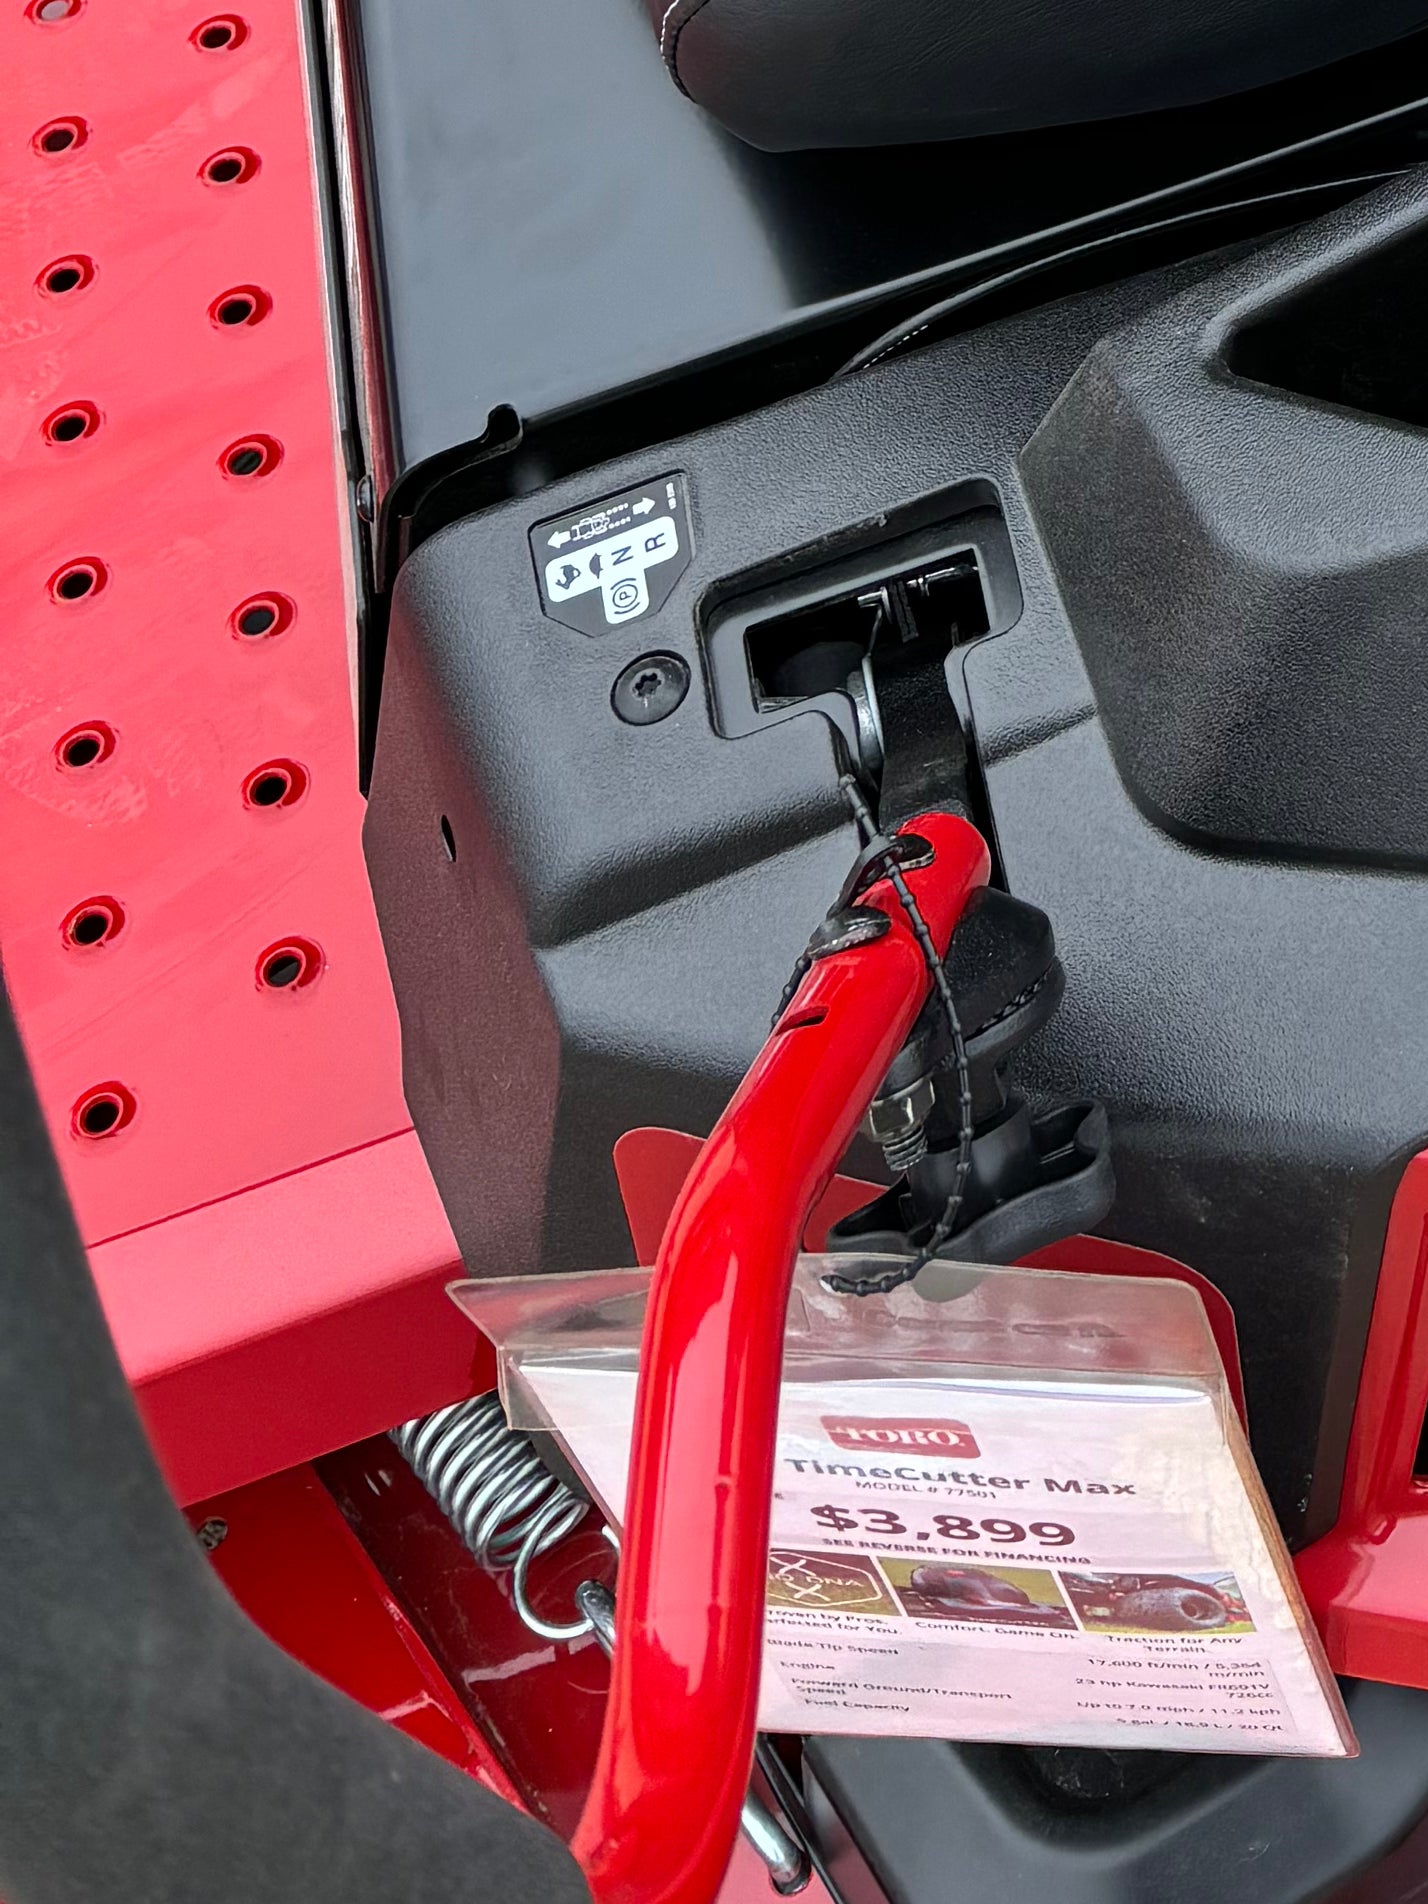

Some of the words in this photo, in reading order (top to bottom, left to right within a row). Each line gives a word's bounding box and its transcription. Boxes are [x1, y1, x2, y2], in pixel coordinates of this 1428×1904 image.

[611, 546, 634, 566] N
[644, 533, 666, 553] R
[784, 1458, 1030, 1490] TimeCutter
[1044, 1477, 1137, 1496] Max
[855, 1481, 924, 1493] MODEL
[944, 1487, 997, 1499] 77501
[809, 1503, 1076, 1547] $3,899
[822, 1538, 853, 1548] SEE
[858, 1541, 938, 1554] REVERSE
[941, 1548, 980, 1558] FOR
[984, 1550, 1091, 1565] FINANCING
[806, 1576, 864, 1587] DNA
[768, 1609, 816, 1619] roven
[820, 1613, 841, 1622] by
[838, 1622, 860, 1630] for
[995, 1627, 1045, 1637] Game
[1105, 1635, 1175, 1644] Traction
[816, 1641, 843, 1652] Tip
[848, 1645, 899, 1655] Speed
[780, 1660, 835, 1670] Engine
[791, 1677, 859, 1689] Forward
[863, 1681, 1013, 1700] Ground/Transport
[1126, 1681, 1204, 1690] Kawasaki
[804, 1697, 839, 1707] Fuel
[843, 1700, 910, 1712] Capacity
